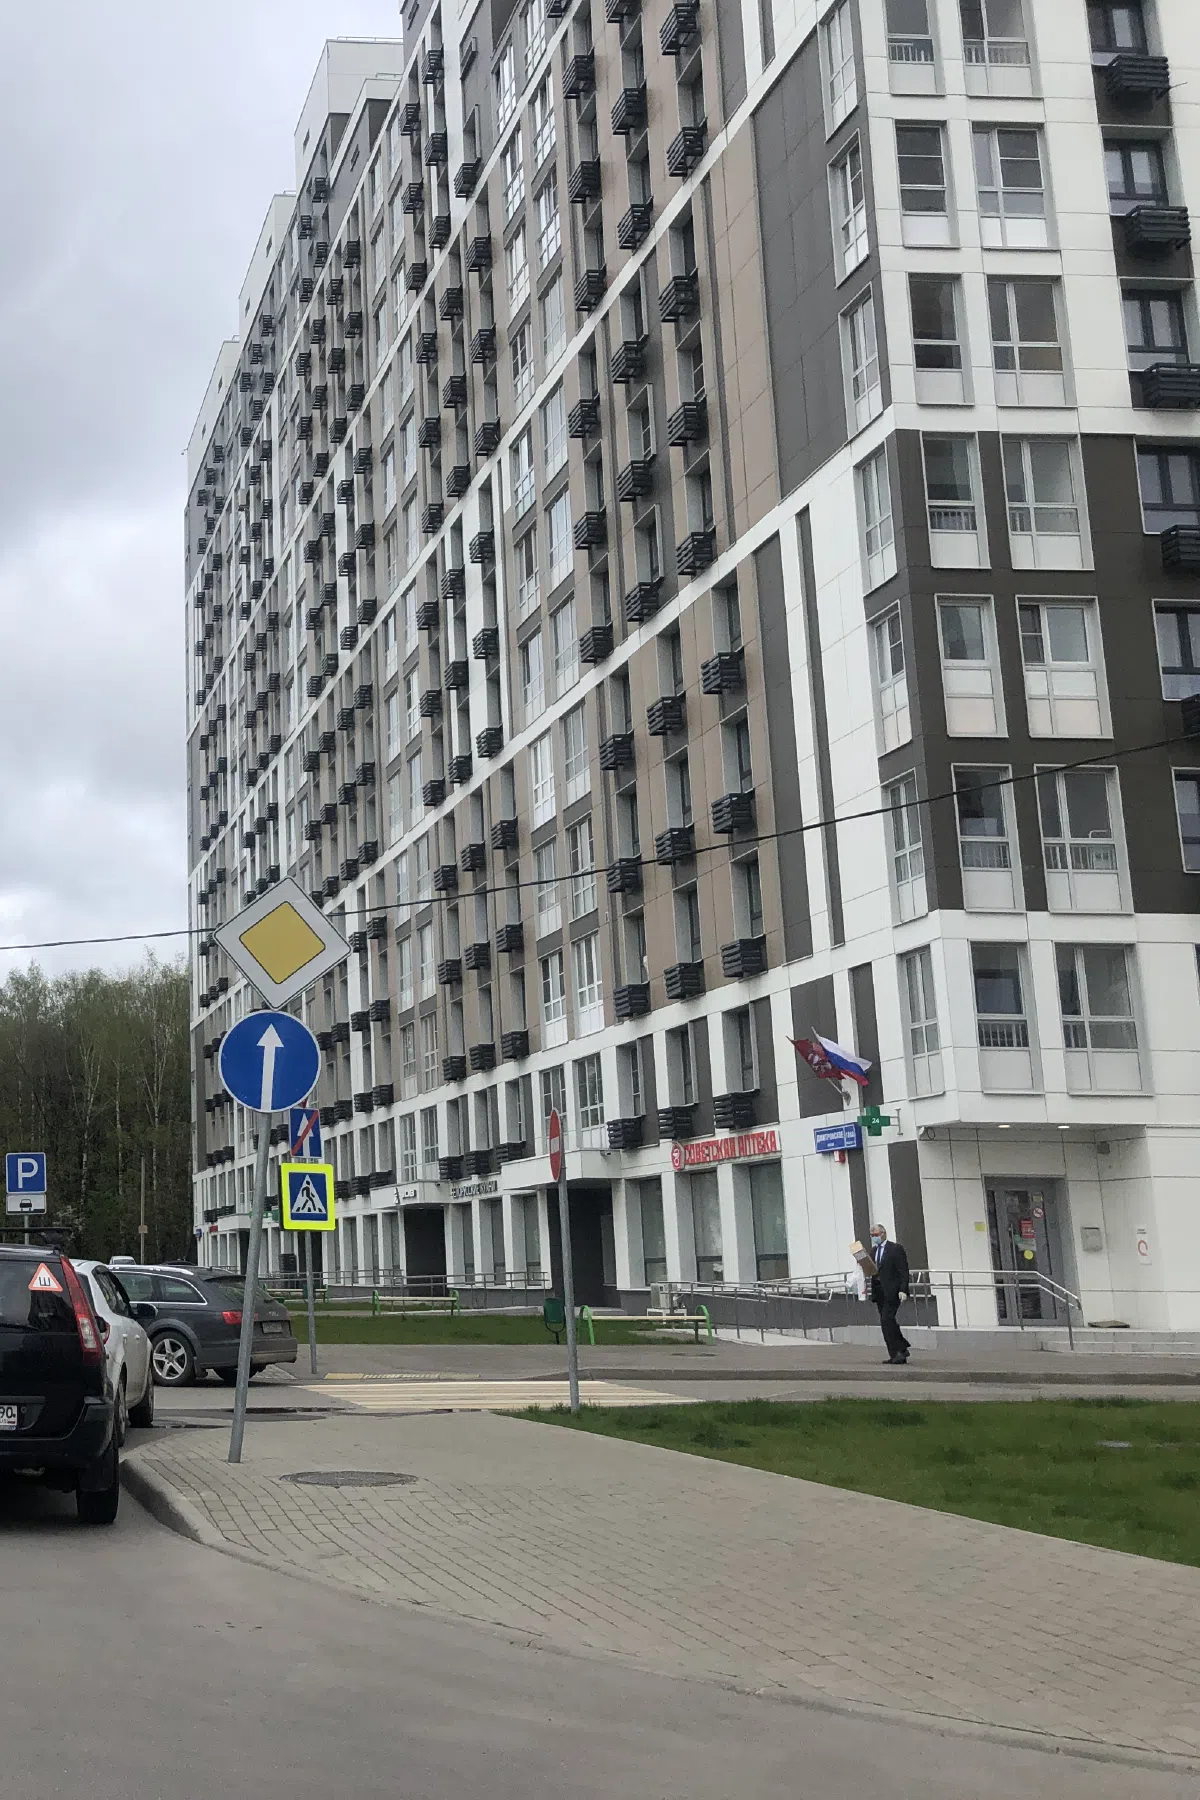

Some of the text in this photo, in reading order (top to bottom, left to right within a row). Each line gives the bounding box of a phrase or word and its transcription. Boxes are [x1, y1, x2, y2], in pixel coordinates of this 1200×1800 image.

[684, 1130, 777, 1165] СОВЕТСКАЯ АПТЕКА
[17, 1158, 39, 1189] P
